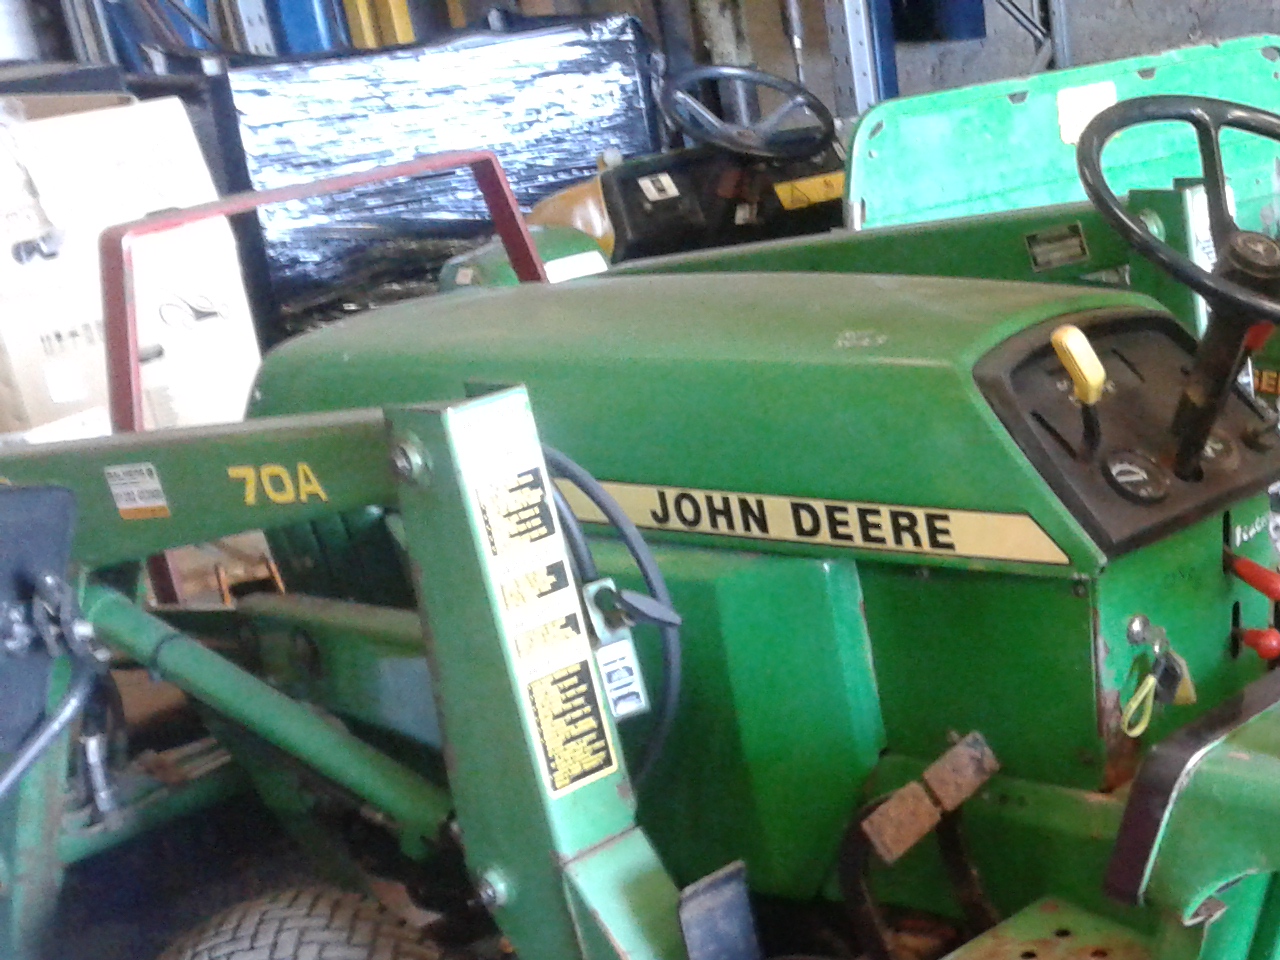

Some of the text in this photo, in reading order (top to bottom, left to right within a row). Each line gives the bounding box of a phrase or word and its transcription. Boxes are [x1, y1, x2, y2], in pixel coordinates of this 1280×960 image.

[227, 461, 329, 506] 70A
[650, 489, 956, 551] JOHN DEERE
